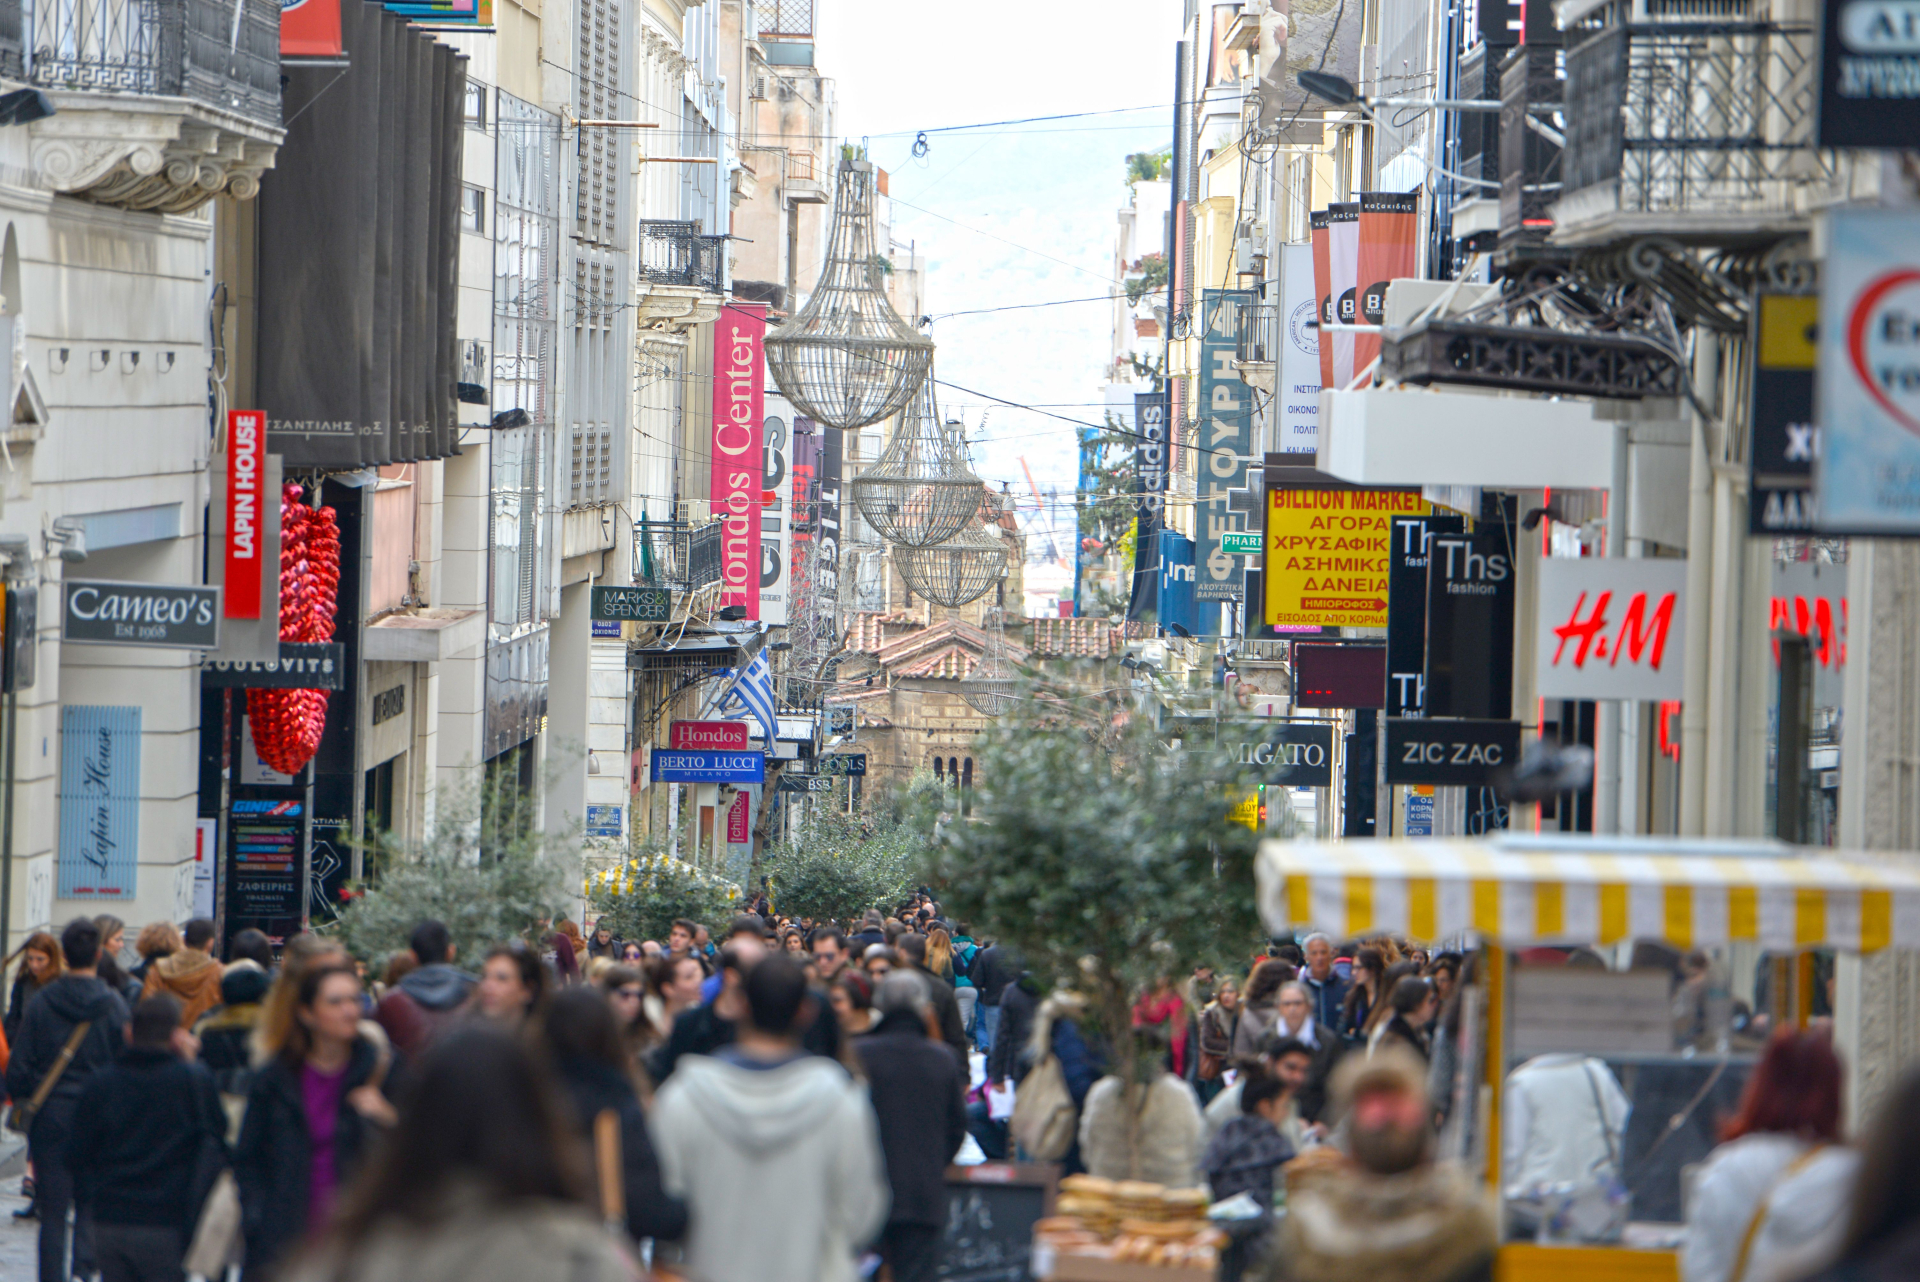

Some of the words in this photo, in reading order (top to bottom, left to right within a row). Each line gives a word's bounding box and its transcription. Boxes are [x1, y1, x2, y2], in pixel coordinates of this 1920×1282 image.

[716, 326, 753, 456] Center
[1294, 385, 1321, 394] ΙΝΣΤΙΤΟ
[1288, 405, 1319, 414] ΟΙΚΟΝΟ
[1294, 425, 1318, 434] ΠΟΛΙΤΙ
[235, 415, 256, 490] HOUSE
[1138, 405, 1164, 512] adidas
[1273, 489, 1345, 510] BILLION
[1350, 491, 1422, 511] MARKET
[233, 493, 255, 559] LAPIN
[1309, 516, 1389, 531] ΑΓΟΡΑ
[720, 472, 750, 609] Hondos
[1224, 535, 1262, 546] PHAR
[1273, 535, 1388, 552] ΧΡΥΣΑΦΙΚ
[1396, 520, 1434, 554] Th
[1285, 556, 1389, 572] ΑΣΗΜΙΚΩ
[1404, 556, 1429, 567] fash
[1436, 540, 1508, 581] Ths
[1197, 583, 1243, 592] ΑΚΟΥΣΤΙΚΑ
[1302, 577, 1389, 592] ΔΑΝΕΙΑ
[1446, 581, 1497, 595] fashion
[1196, 591, 1243, 599] ΒΑΡΗΚΟ
[69, 586, 213, 626] Cameo's
[603, 603, 665, 618] SPENCER
[1304, 600, 1376, 609] ΗΜΙΟΡΟΦΟΣ
[1276, 613, 1321, 623] ΕΙΣΟΔΟΣ
[1324, 614, 1346, 624] ΑΠΟ
[1349, 614, 1389, 624] ΚΟΡΝΑ
[115, 623, 134, 637] Est
[138, 624, 167, 640] 1968
[1552, 590, 1678, 671] H&M
[200, 657, 335, 674] ZOULOVITS
[1391, 673, 1426, 707] Th
[679, 726, 742, 743] Hondos
[1402, 742, 1445, 764] ZIC
[1450, 743, 1503, 766] ZAC
[83, 726, 112, 798] House
[659, 756, 705, 768] BERTO
[820, 758, 865, 770] OOLS
[808, 779, 831, 790] BSB
[231, 800, 280, 813] GINIS
[237, 882, 294, 892] ΖΑΦΕΙΡΗΣ
